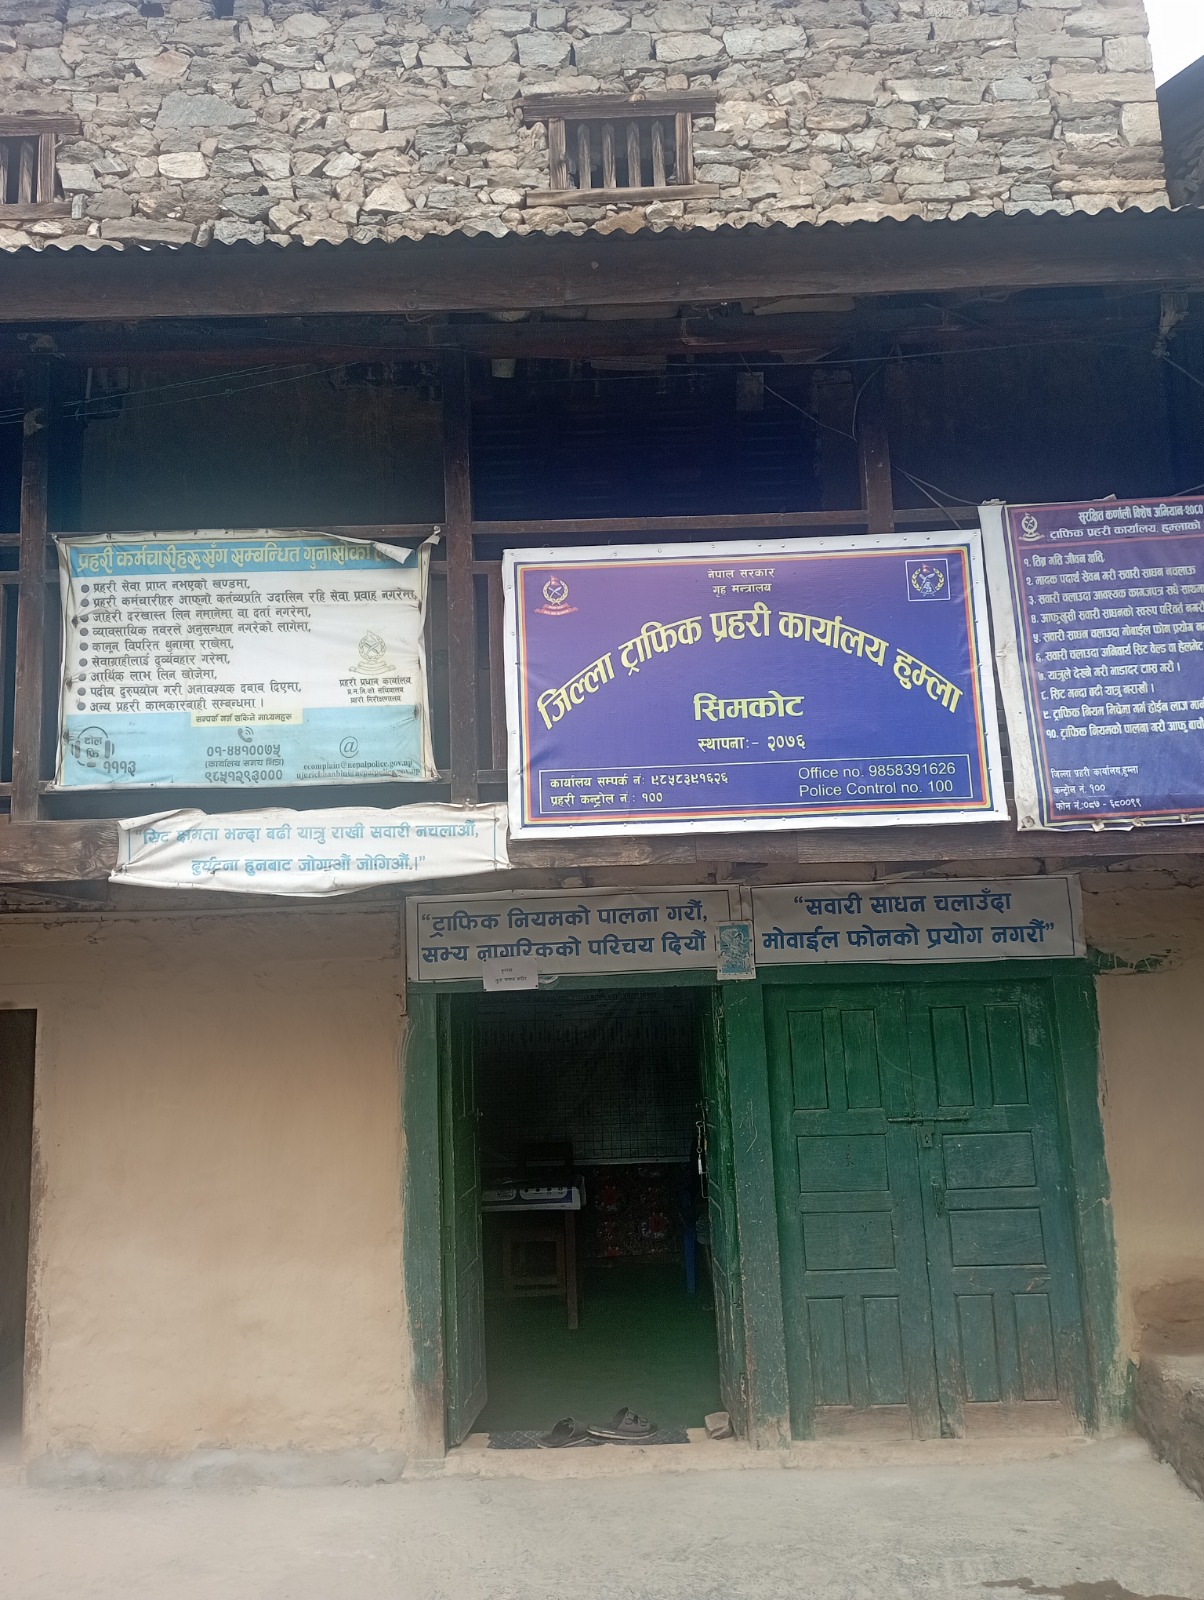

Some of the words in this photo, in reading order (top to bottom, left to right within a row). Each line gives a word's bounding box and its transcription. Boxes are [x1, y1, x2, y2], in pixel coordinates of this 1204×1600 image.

[1050, 529, 1083, 541] ट्राफिक
[1087, 525, 1110, 537] प्रहरी
[78, 546, 112, 574] प्रहरी
[232, 542, 300, 568] सम्बन्धित
[707, 569, 735, 579] नेपाल
[740, 568, 775, 578] सरकार
[93, 580, 116, 594] प्रहरी
[122, 580, 140, 592] सेवा
[146, 580, 167, 592] प्राप्त
[172, 578, 207, 591] नभएको
[713, 585, 726, 597] गृह
[731, 583, 772, 593] मन्त्रालय
[93, 594, 116, 608] प्रहरी
[267, 590, 303, 602] उदासिन
[310, 589, 325, 602] रहि
[330, 590, 348, 601] सेवा
[354, 590, 376, 602] प्रवाह
[93, 610, 122, 622] जाहेरी
[128, 610, 167, 621] दरखास्त
[172, 609, 191, 620] लिन
[196, 607, 232, 619] नमानेमा
[238, 608, 248, 618] वा
[254, 605, 270, 618] दर्ता
[152, 624, 182, 636] तवरले
[187, 624, 233, 636] अनुसन्धान
[238, 620, 272, 633] नगरेको
[125, 638, 159, 650] विपरित
[166, 639, 195, 652] थुनामा
[537, 652, 615, 730] जिल्ला
[618, 616, 702, 676] ट्राफिक
[710, 602, 772, 643] प्रहरी
[778, 611, 889, 667] कार्यालय
[893, 648, 963, 714] हुम्ला
[91, 669, 124, 682] आर्थिक
[130, 671, 151, 681] लाभ
[157, 668, 176, 680] लिन
[90, 686, 115, 697] पदीय
[120, 684, 158, 698] दुरुपयोग
[164, 683, 182, 694] गरी
[188, 684, 235, 694] अनावश्यक
[90, 702, 111, 712] अन्य
[116, 700, 140, 712] प्रहरी
[212, 699, 256, 709] सम्बन्धमा
[694, 690, 804, 722] सिमकोट
[207, 744, 281, 757] ०१-४४१००७५
[767, 734, 806, 752] २०७६
[103, 760, 136, 777] १११३
[205, 769, 283, 784] ९८५१२९३०००
[798, 766, 838, 779] Office
[843, 768, 864, 777] no.
[869, 762, 955, 777] 9858391626
[550, 775, 592, 788] कार्यालय
[597, 773, 628, 786] सम्पर्क
[651, 773, 728, 786] ९८५८३९१६२६
[800, 784, 841, 797] Police
[847, 782, 896, 795] Control
[901, 783, 922, 793] no.
[928, 780, 953, 792] 100
[1090, 784, 1105, 794] १००
[550, 793, 575, 808] प्रहरी
[580, 792, 614, 808] कन्ट्रोल
[642, 793, 663, 803] १००
[224, 826, 261, 843] भन्दा
[266, 823, 292, 840] बढी
[298, 824, 327, 843] यात्रु
[331, 819, 365, 840] राखी
[370, 820, 410, 839] सवारी
[244, 856, 293, 876] हुनबाट
[870, 894, 926, 914] साधन
[933, 887, 1012, 914] चलाउँदा
[507, 904, 590, 929] नियमको
[597, 906, 658, 924] पालना
[762, 925, 840, 952] मोवाईल
[846, 923, 920, 948] फोनको
[926, 921, 984, 949] प्रयोग
[422, 945, 469, 963] सभ्य
[477, 936, 582, 960] नागरिकको
[587, 933, 655, 956] परिचय
[661, 929, 706, 955] दियौं
